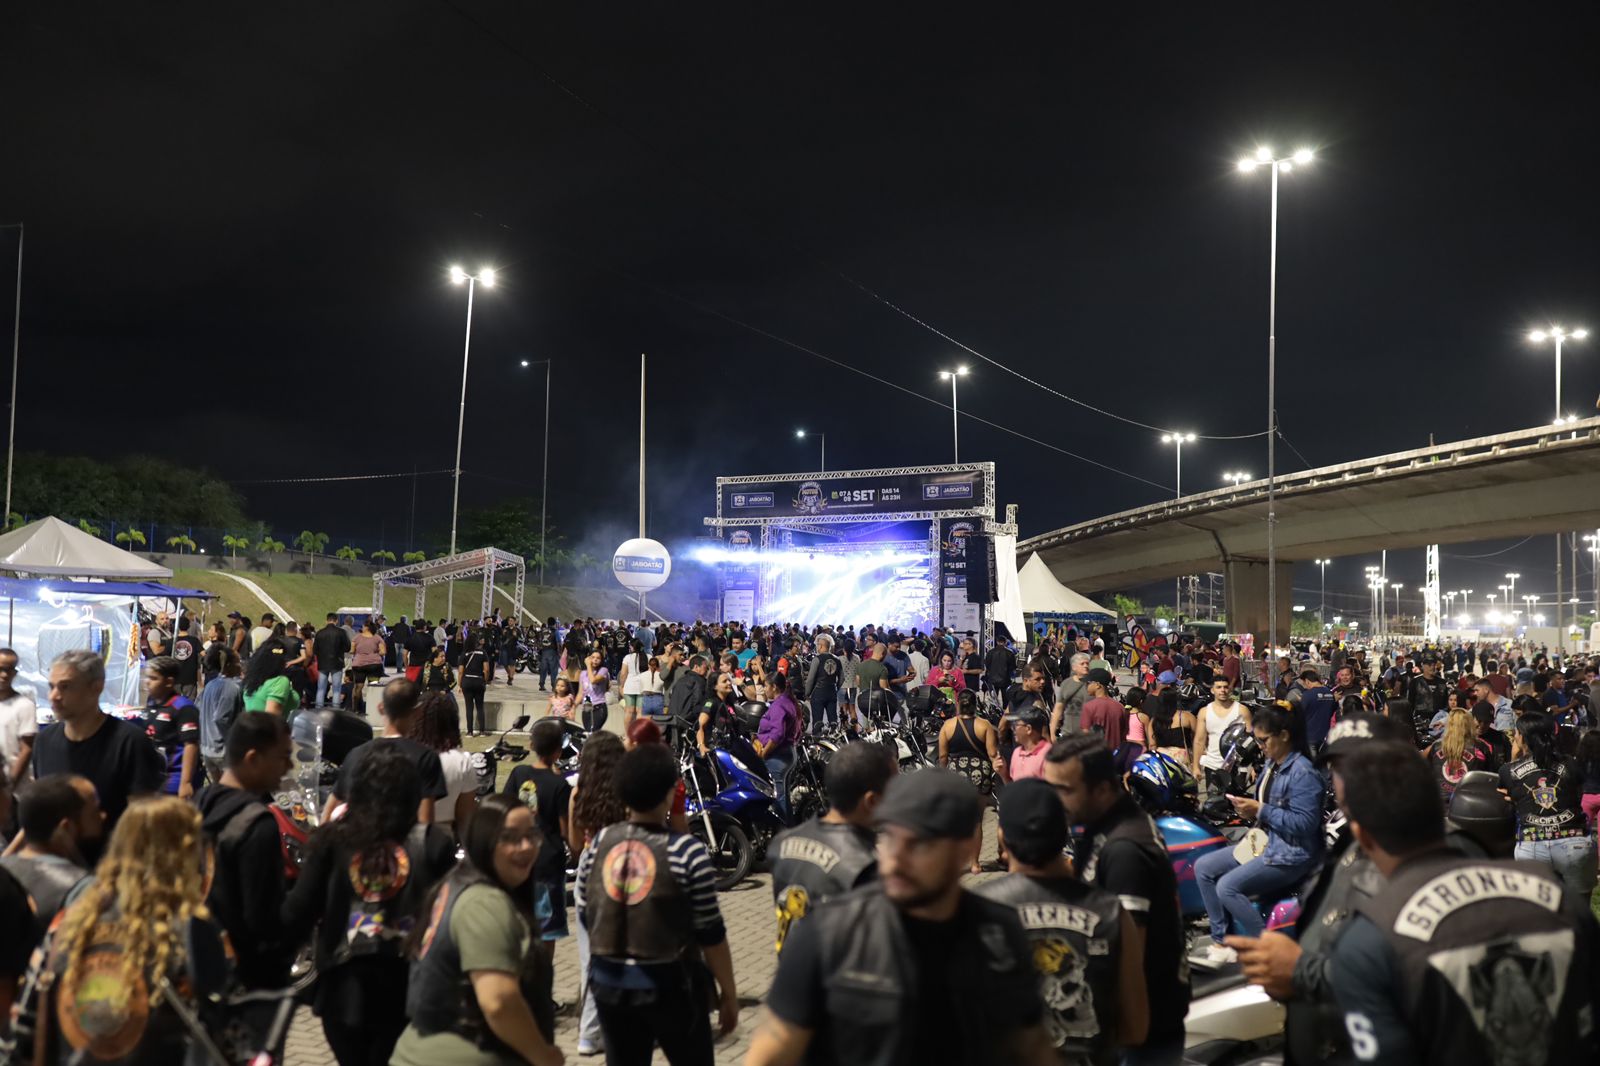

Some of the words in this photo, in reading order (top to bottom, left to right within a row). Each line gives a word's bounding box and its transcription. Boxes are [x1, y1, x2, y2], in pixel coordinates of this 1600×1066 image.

[943, 485, 970, 494] JABOATÃO
[852, 489, 876, 502] SET
[890, 493, 901, 501] 23H
[631, 560, 663, 569] JABOATÃO
[1406, 870, 1552, 930] STRONG'S
